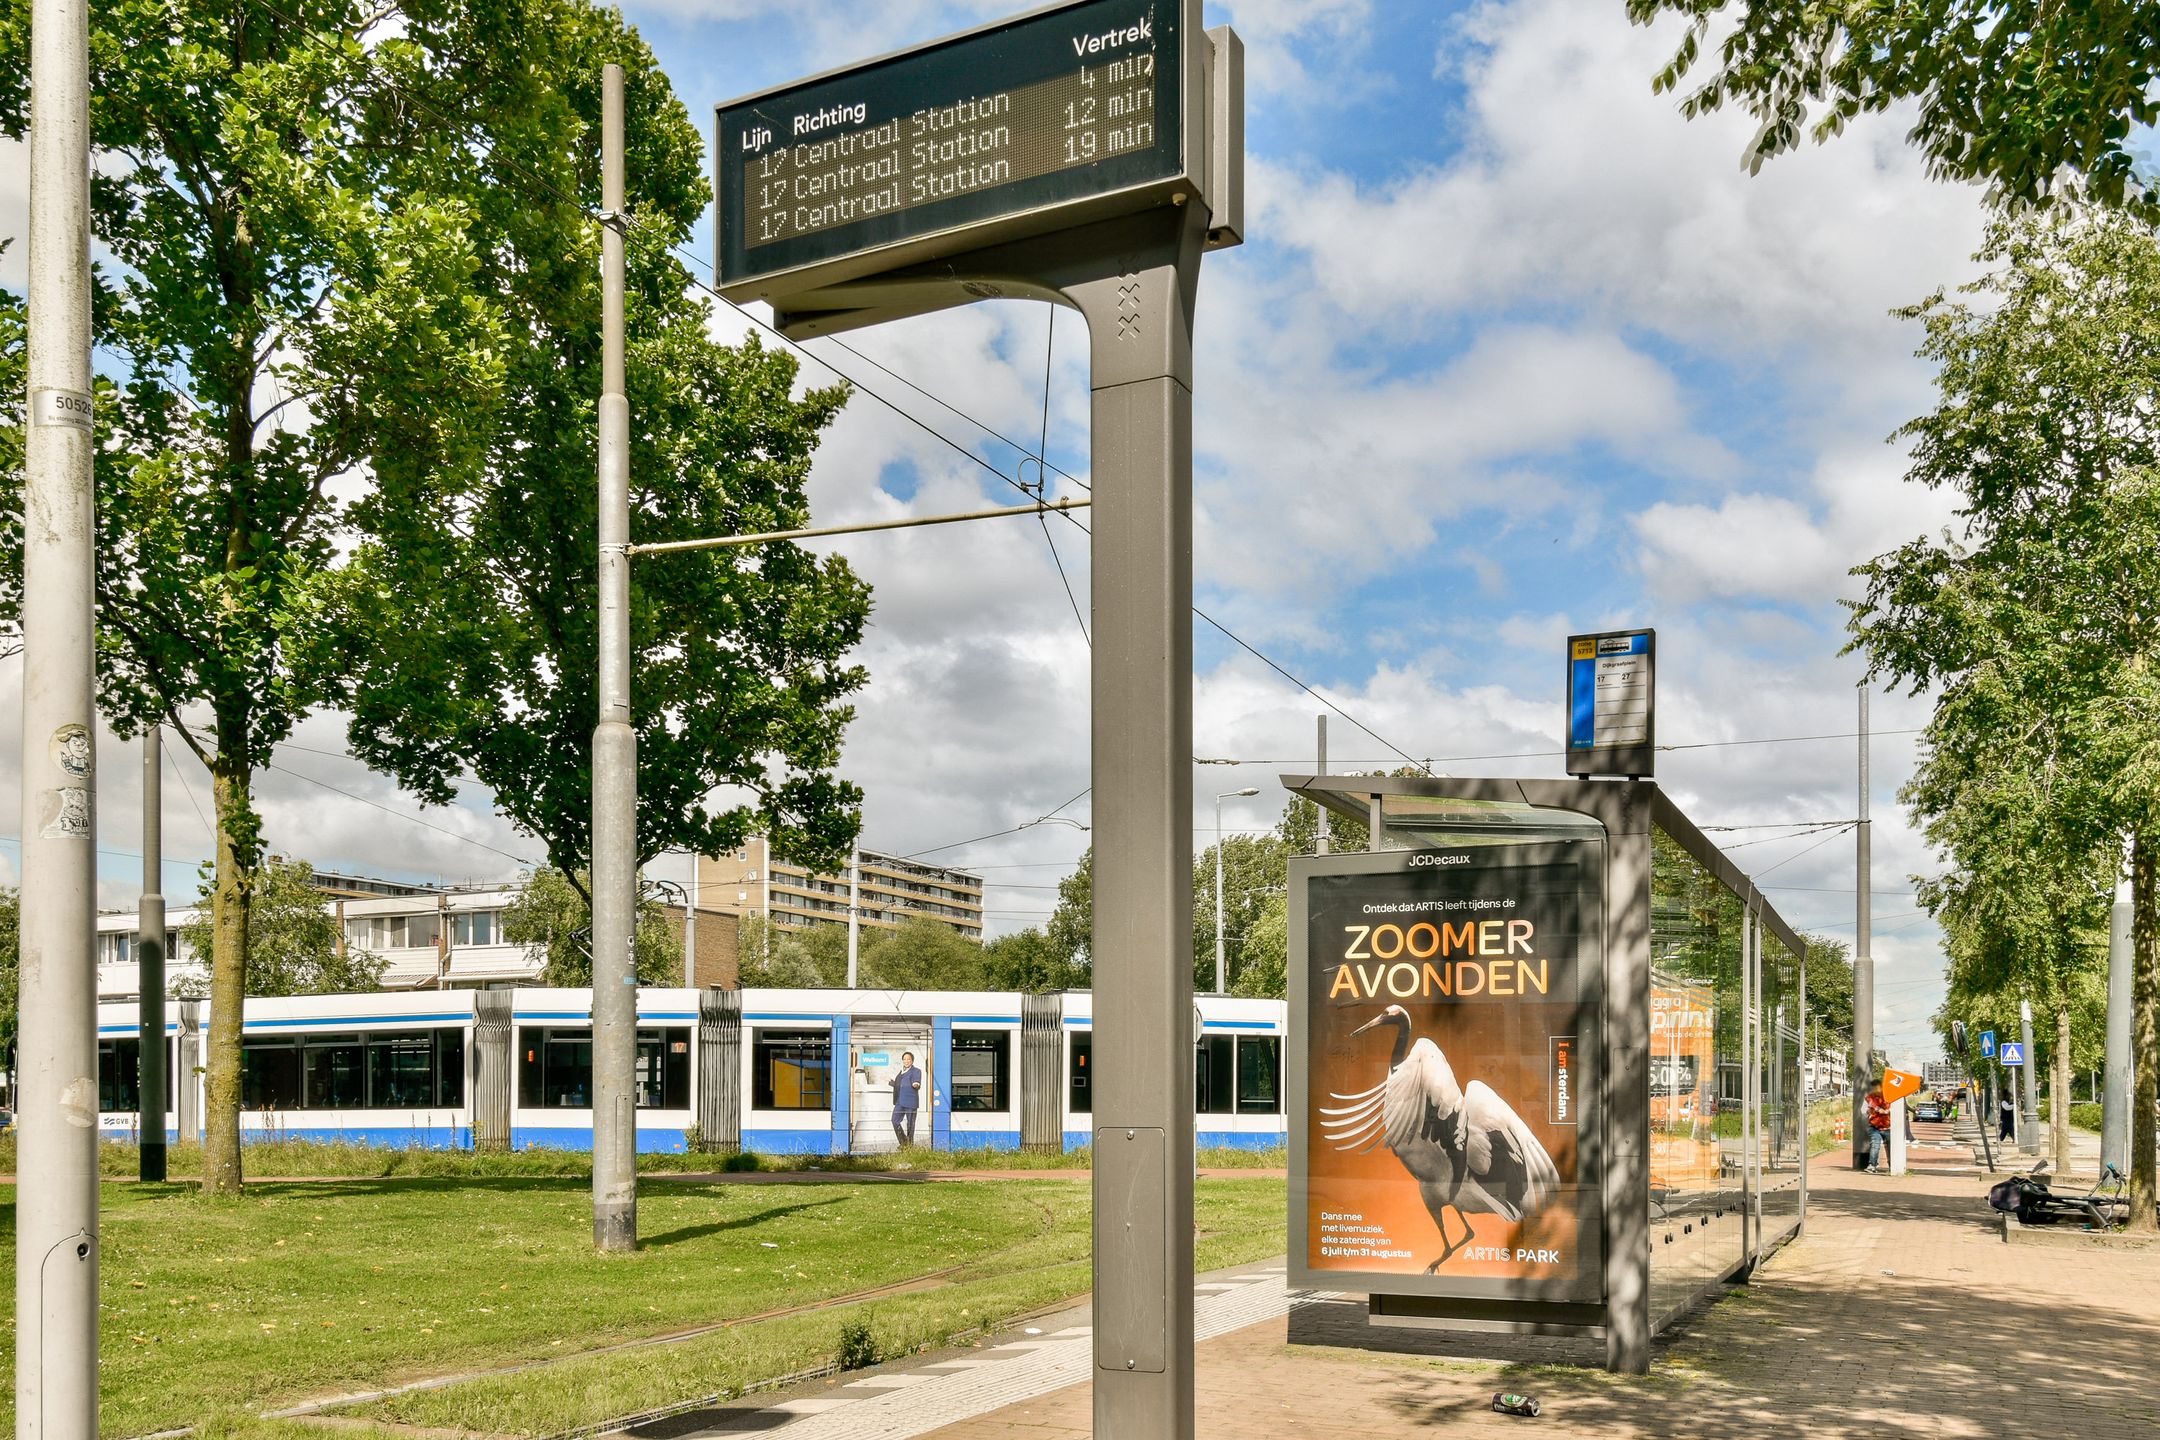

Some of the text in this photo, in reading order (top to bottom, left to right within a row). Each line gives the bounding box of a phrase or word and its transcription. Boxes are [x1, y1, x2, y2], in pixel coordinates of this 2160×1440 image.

[742, 17, 1152, 152] Lijn Richting Vertrek
[760, 52, 1154, 178] 17 Centraal Station 4 min
[760, 86, 1152, 209] 17 Centraal Station 12 min
[760, 121, 1152, 240] 17 Centraal Station 19 min
[1597, 672, 1630, 683] 17 27
[1408, 854, 1471, 867] JCDecaux
[1362, 898, 1516, 914] Ontdek dat ARTIS leeft tijdens de
[1344, 919, 1535, 959] ZOOMER
[1329, 959, 1549, 999] AVONDEN
[674, 1042, 685, 1053] 17
[1558, 1050, 1571, 1120] amsterdam.
[1321, 1212, 1362, 1221] Dans mee
[1321, 1224, 1385, 1234] met livemuziek,
[1321, 1235, 1339, 1244] elke
[1339, 1236, 1376, 1247] zaterdag
[1321, 1247, 1412, 1259] 6 juli t/m 31 augustus
[1463, 1246, 1560, 1263] ARTIS PARK
